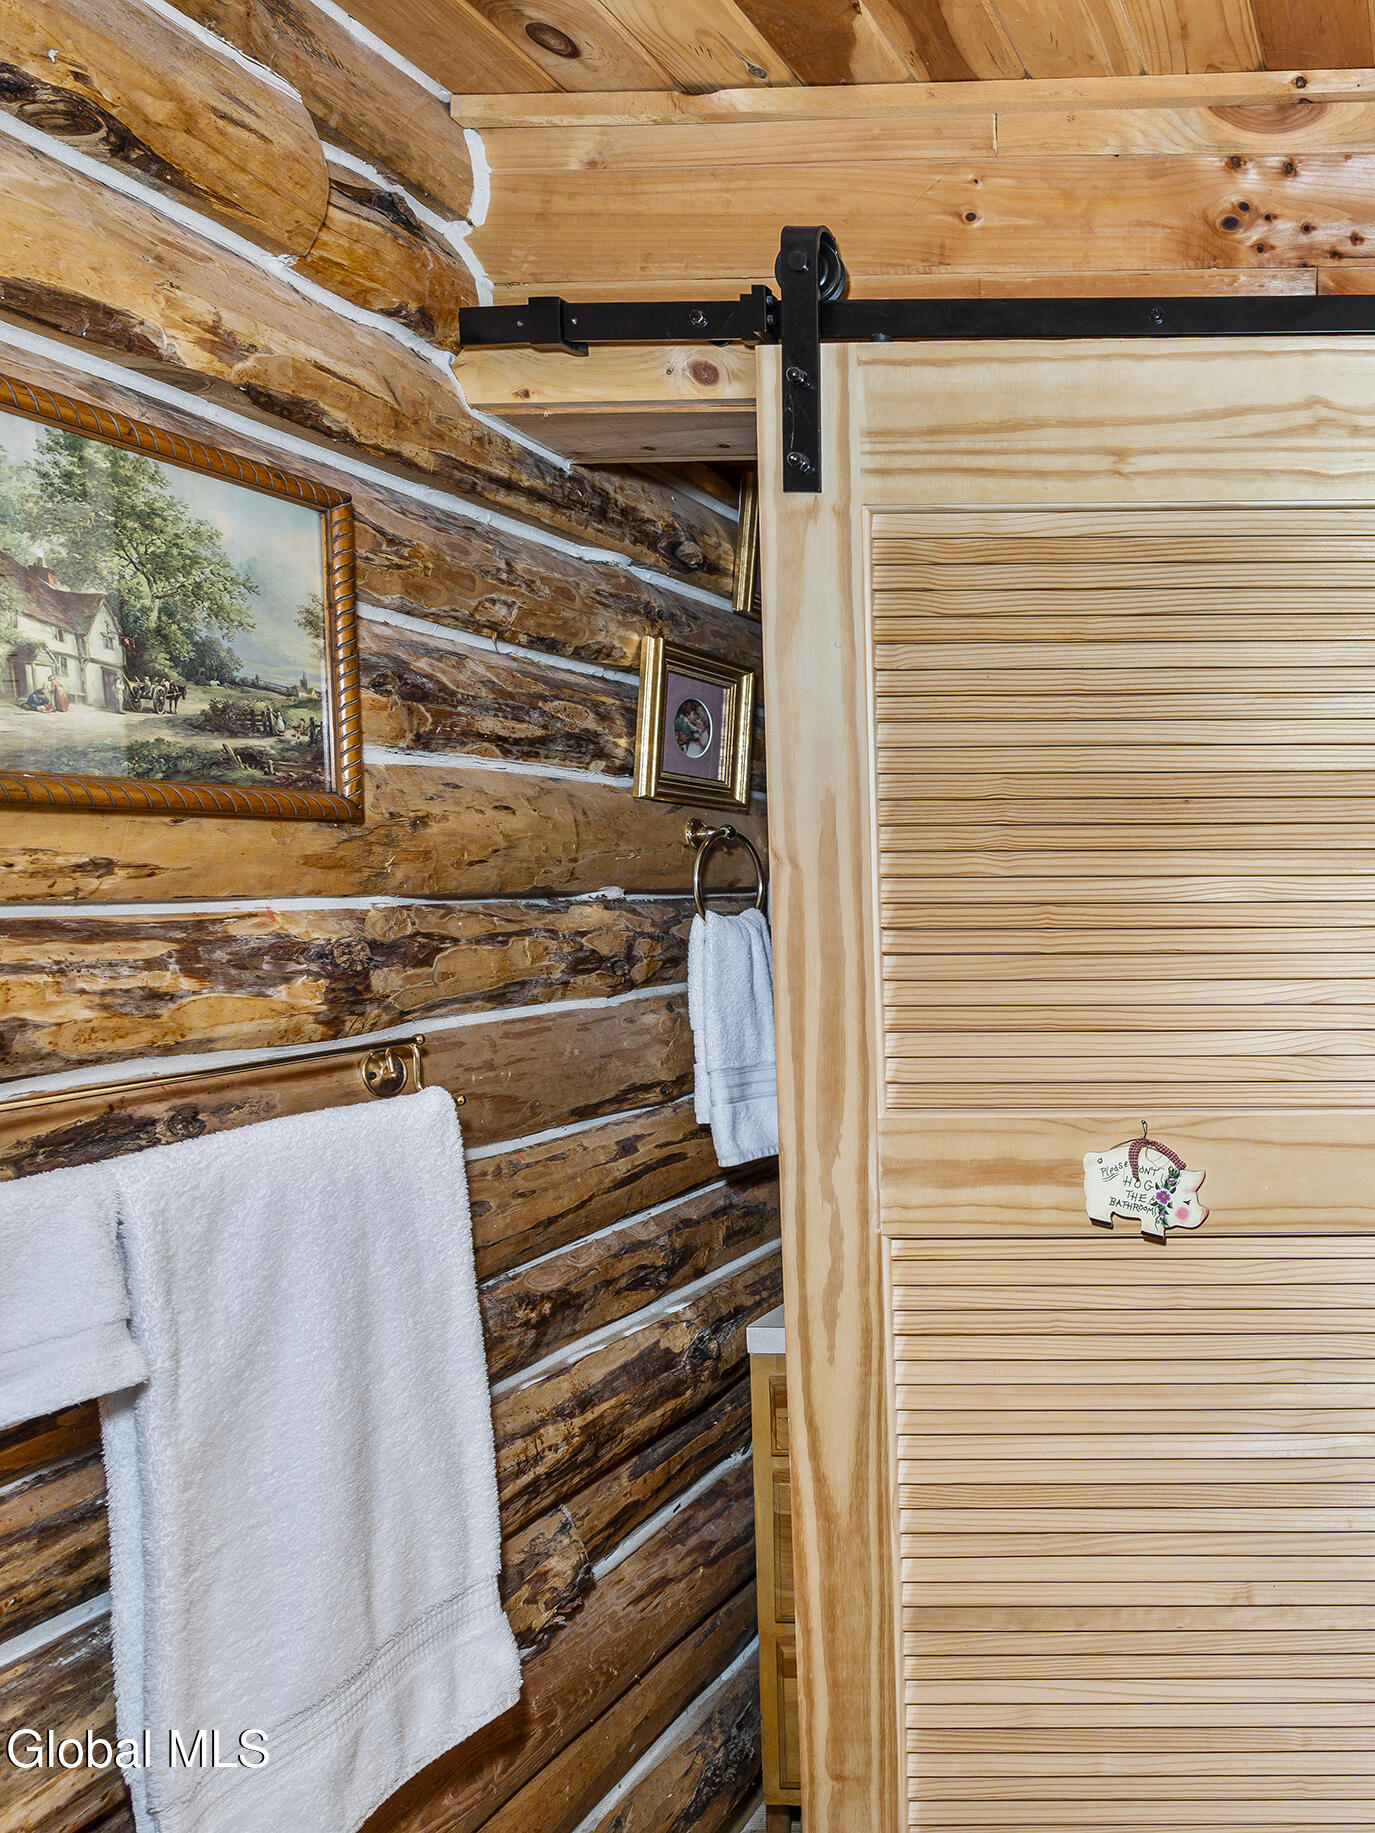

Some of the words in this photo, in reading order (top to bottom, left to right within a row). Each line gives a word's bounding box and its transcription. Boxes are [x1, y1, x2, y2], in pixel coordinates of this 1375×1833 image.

[1100, 1161, 1128, 1177] Please
[1138, 1165, 1159, 1176] ON'T
[1123, 1176, 1154, 1191] HOG
[1125, 1190, 1147, 1203] THE
[1108, 1196, 1155, 1216] BATHROOM
